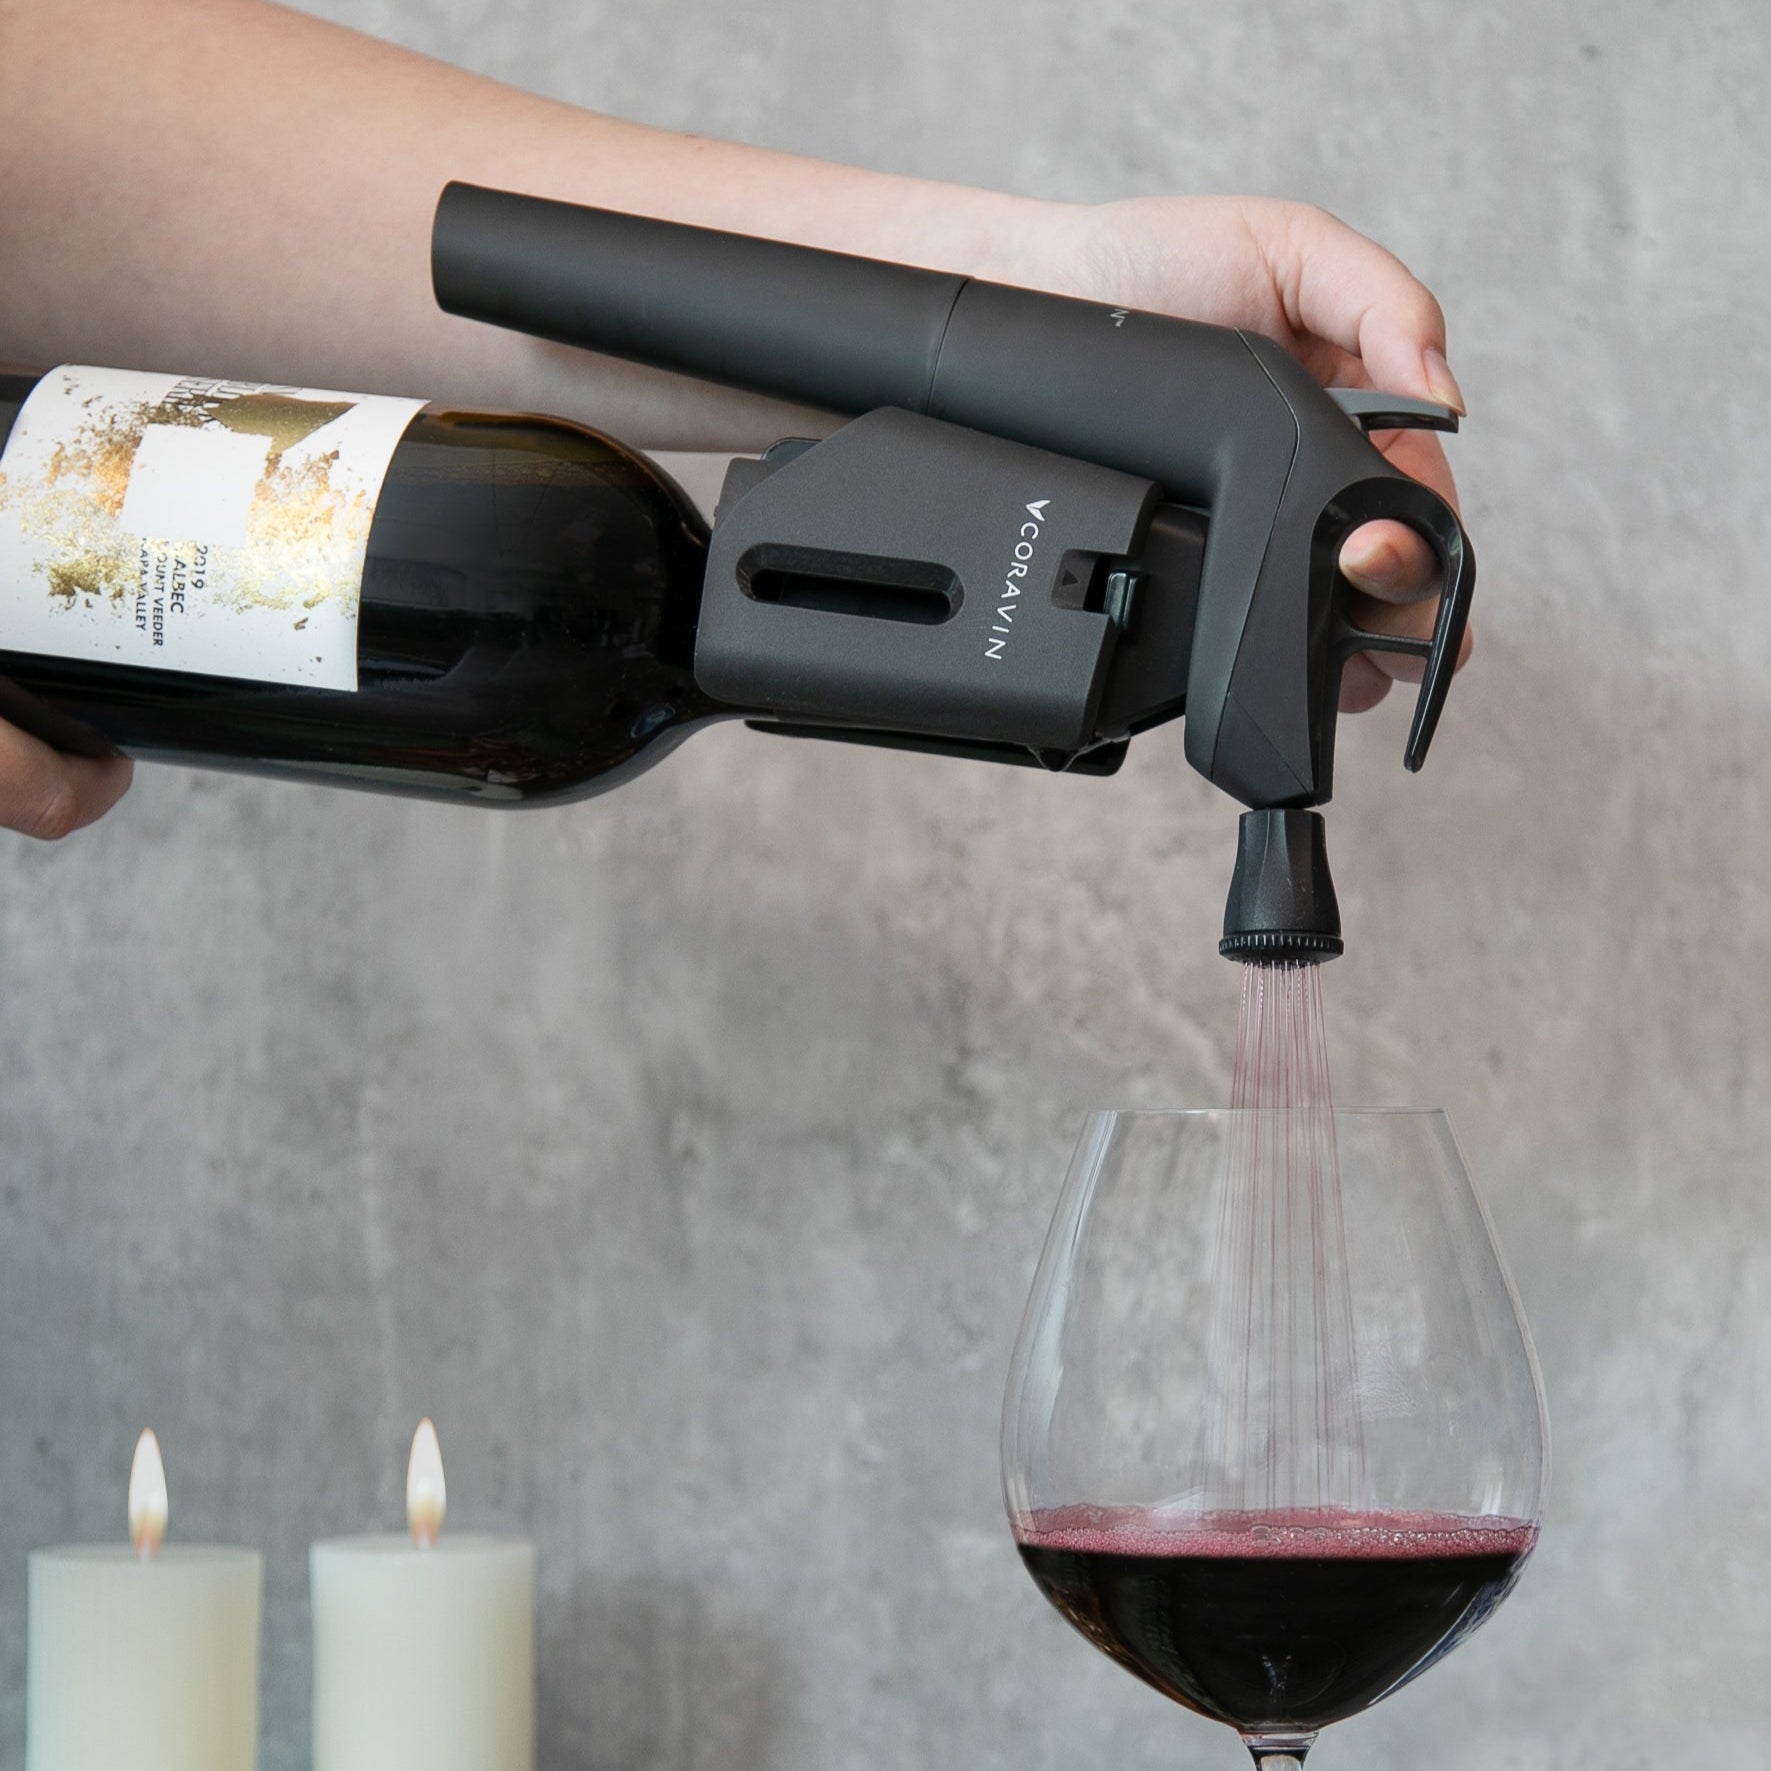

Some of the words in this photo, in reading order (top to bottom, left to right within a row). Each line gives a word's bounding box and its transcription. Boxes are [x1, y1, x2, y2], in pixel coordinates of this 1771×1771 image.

[153, 541, 170, 593] OUNT
[170, 544, 187, 615] ALBEC
[190, 544, 209, 590] 2019
[984, 521, 1039, 660] CORAVIN
[135, 582, 148, 632] VALLEY
[152, 597, 164, 647] VEEDER
